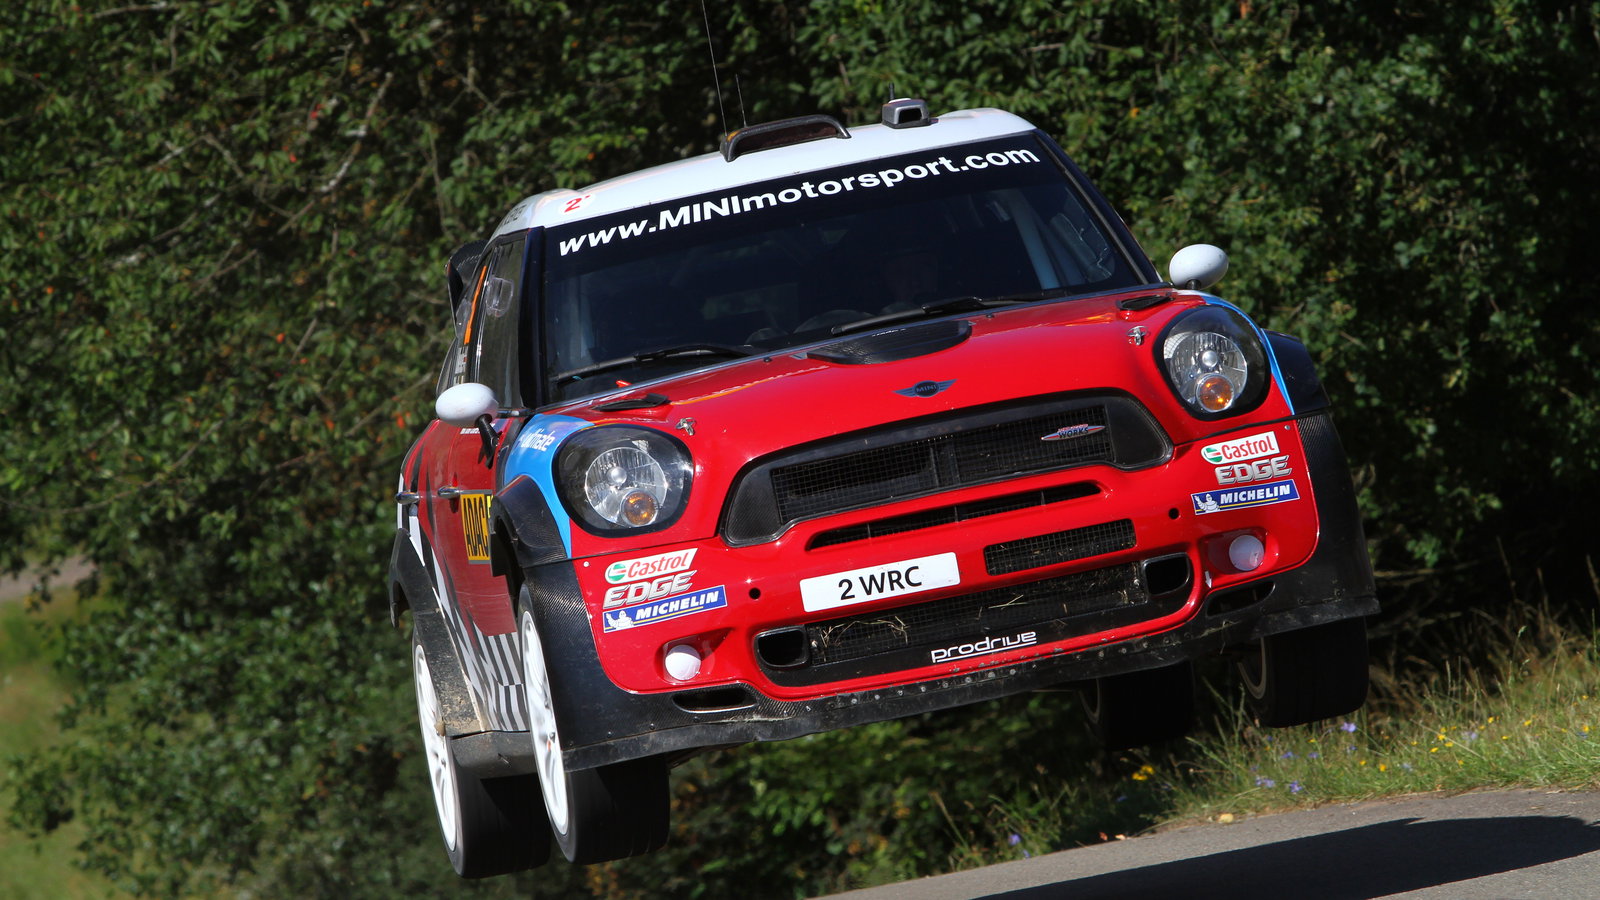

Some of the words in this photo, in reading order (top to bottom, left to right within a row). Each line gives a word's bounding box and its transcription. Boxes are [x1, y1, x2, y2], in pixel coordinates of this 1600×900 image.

[559, 146, 1040, 256] www.MINImotorsport.com
[916, 384, 938, 393] MINI
[1058, 427, 1089, 439] WORKS
[1221, 435, 1275, 460] Castrol
[1214, 455, 1292, 485] EDGE
[1220, 484, 1290, 504] MICHELIN
[627, 552, 689, 578] Castrol
[603, 570, 697, 609] EDGE
[838, 579, 855, 600] 2
[858, 566, 922, 596] WRC
[635, 591, 719, 620] MICHELIN
[931, 631, 1037, 663] prodrive
